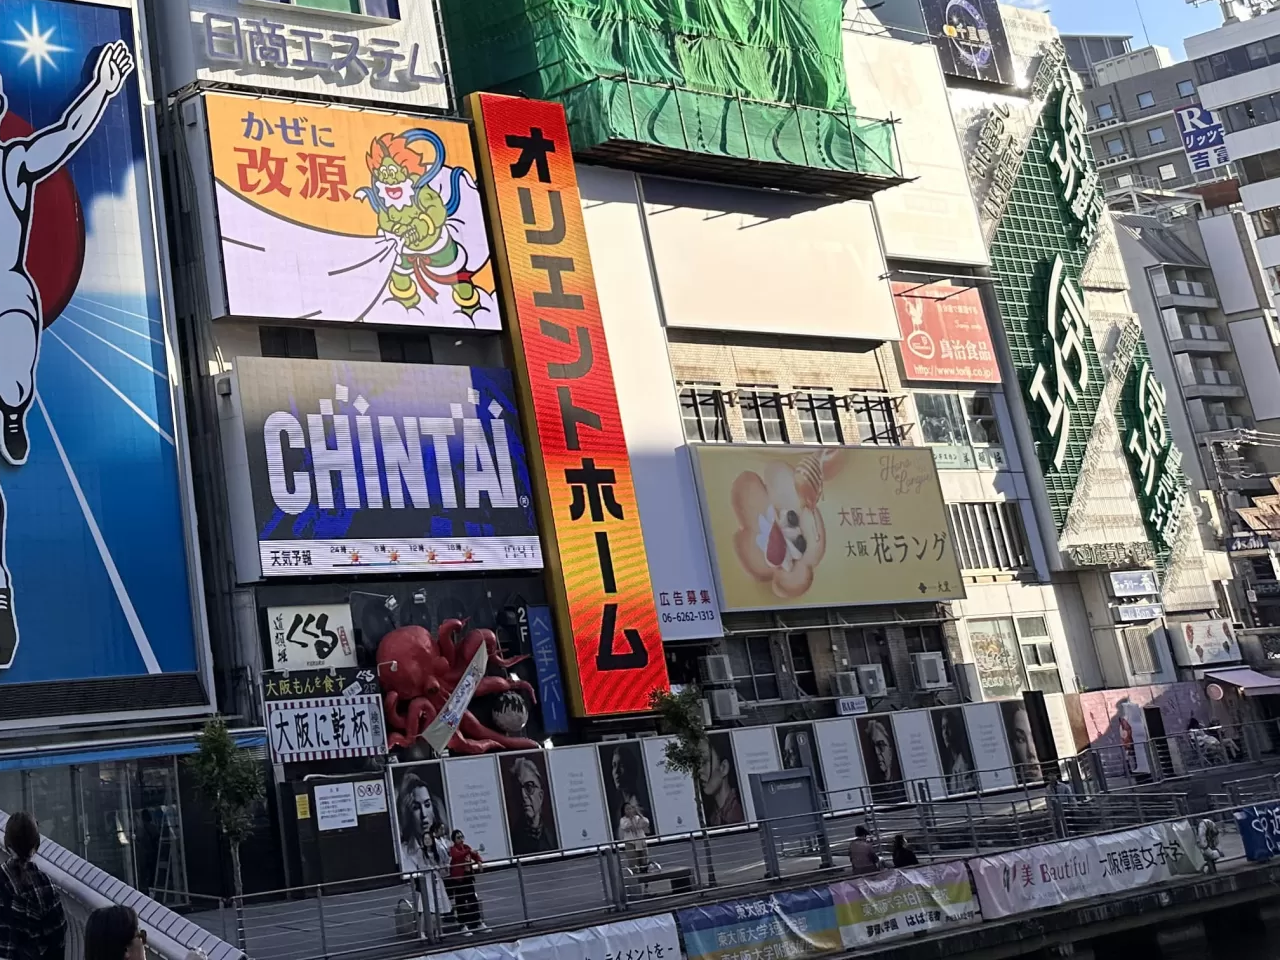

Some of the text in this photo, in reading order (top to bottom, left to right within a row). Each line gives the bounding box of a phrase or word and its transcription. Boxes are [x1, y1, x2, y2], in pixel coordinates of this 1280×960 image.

[204, 13, 446, 86] 日商エステム
[241, 111, 334, 148] かぜに
[233, 146, 352, 203] 改源
[1030, 274, 1090, 437] エイブル
[505, 127, 648, 673] オリエントホーム
[263, 395, 519, 515] CHINTAI
[838, 507, 892, 526] 大阪土産
[270, 550, 312, 566] 天気予報
[870, 531, 947, 564] 花ラング
[659, 590, 712, 606] 広告募集
[662, 611, 715, 624] 06-6262-1313
[265, 675, 346, 696] 大阪もんを食す
[275, 707, 369, 751] 大阪に乾杯
[1040, 854, 1091, 884] Bautiful
